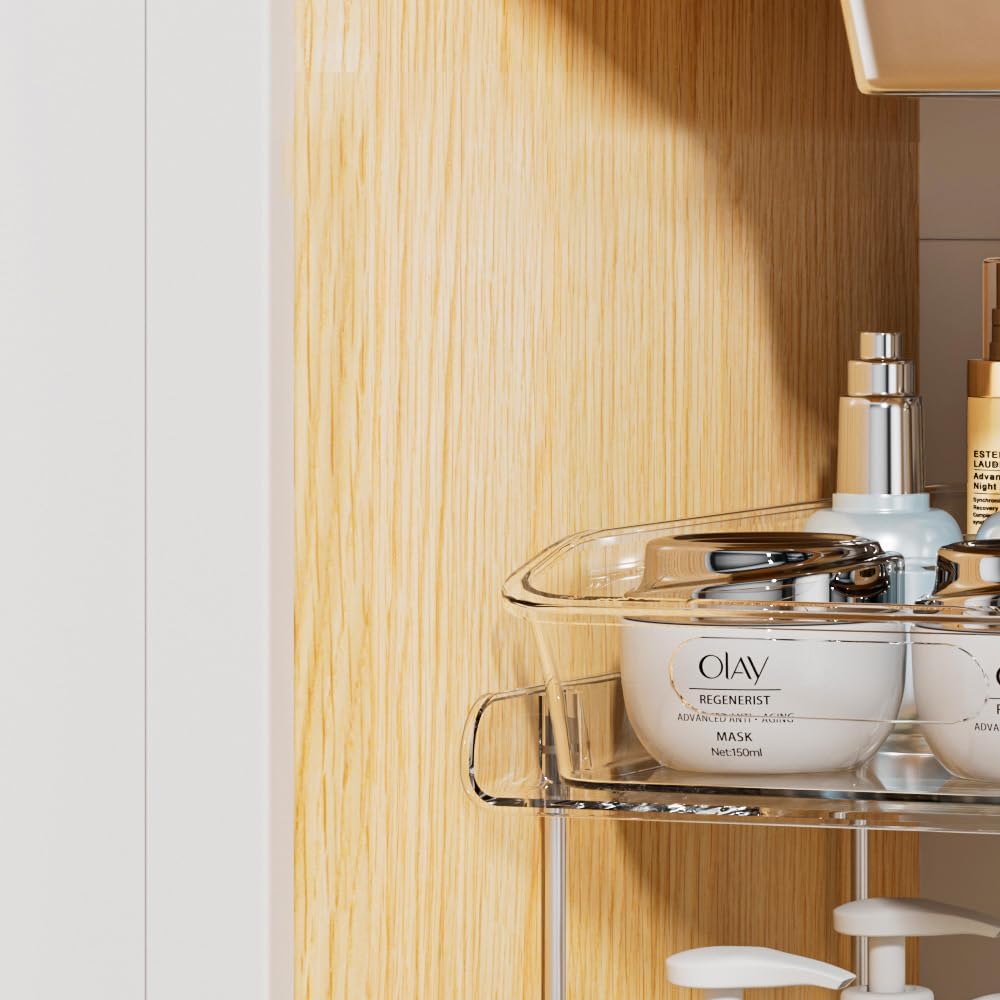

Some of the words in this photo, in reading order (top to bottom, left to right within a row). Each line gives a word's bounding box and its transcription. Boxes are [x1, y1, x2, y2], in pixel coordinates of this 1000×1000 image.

[973, 482, 997, 491] Night
[699, 694, 771, 705] REGENERIST
[677, 712, 726, 723] ADVANCED
[716, 731, 753, 742] MASK
[711, 747, 763, 757] Net:150ml
